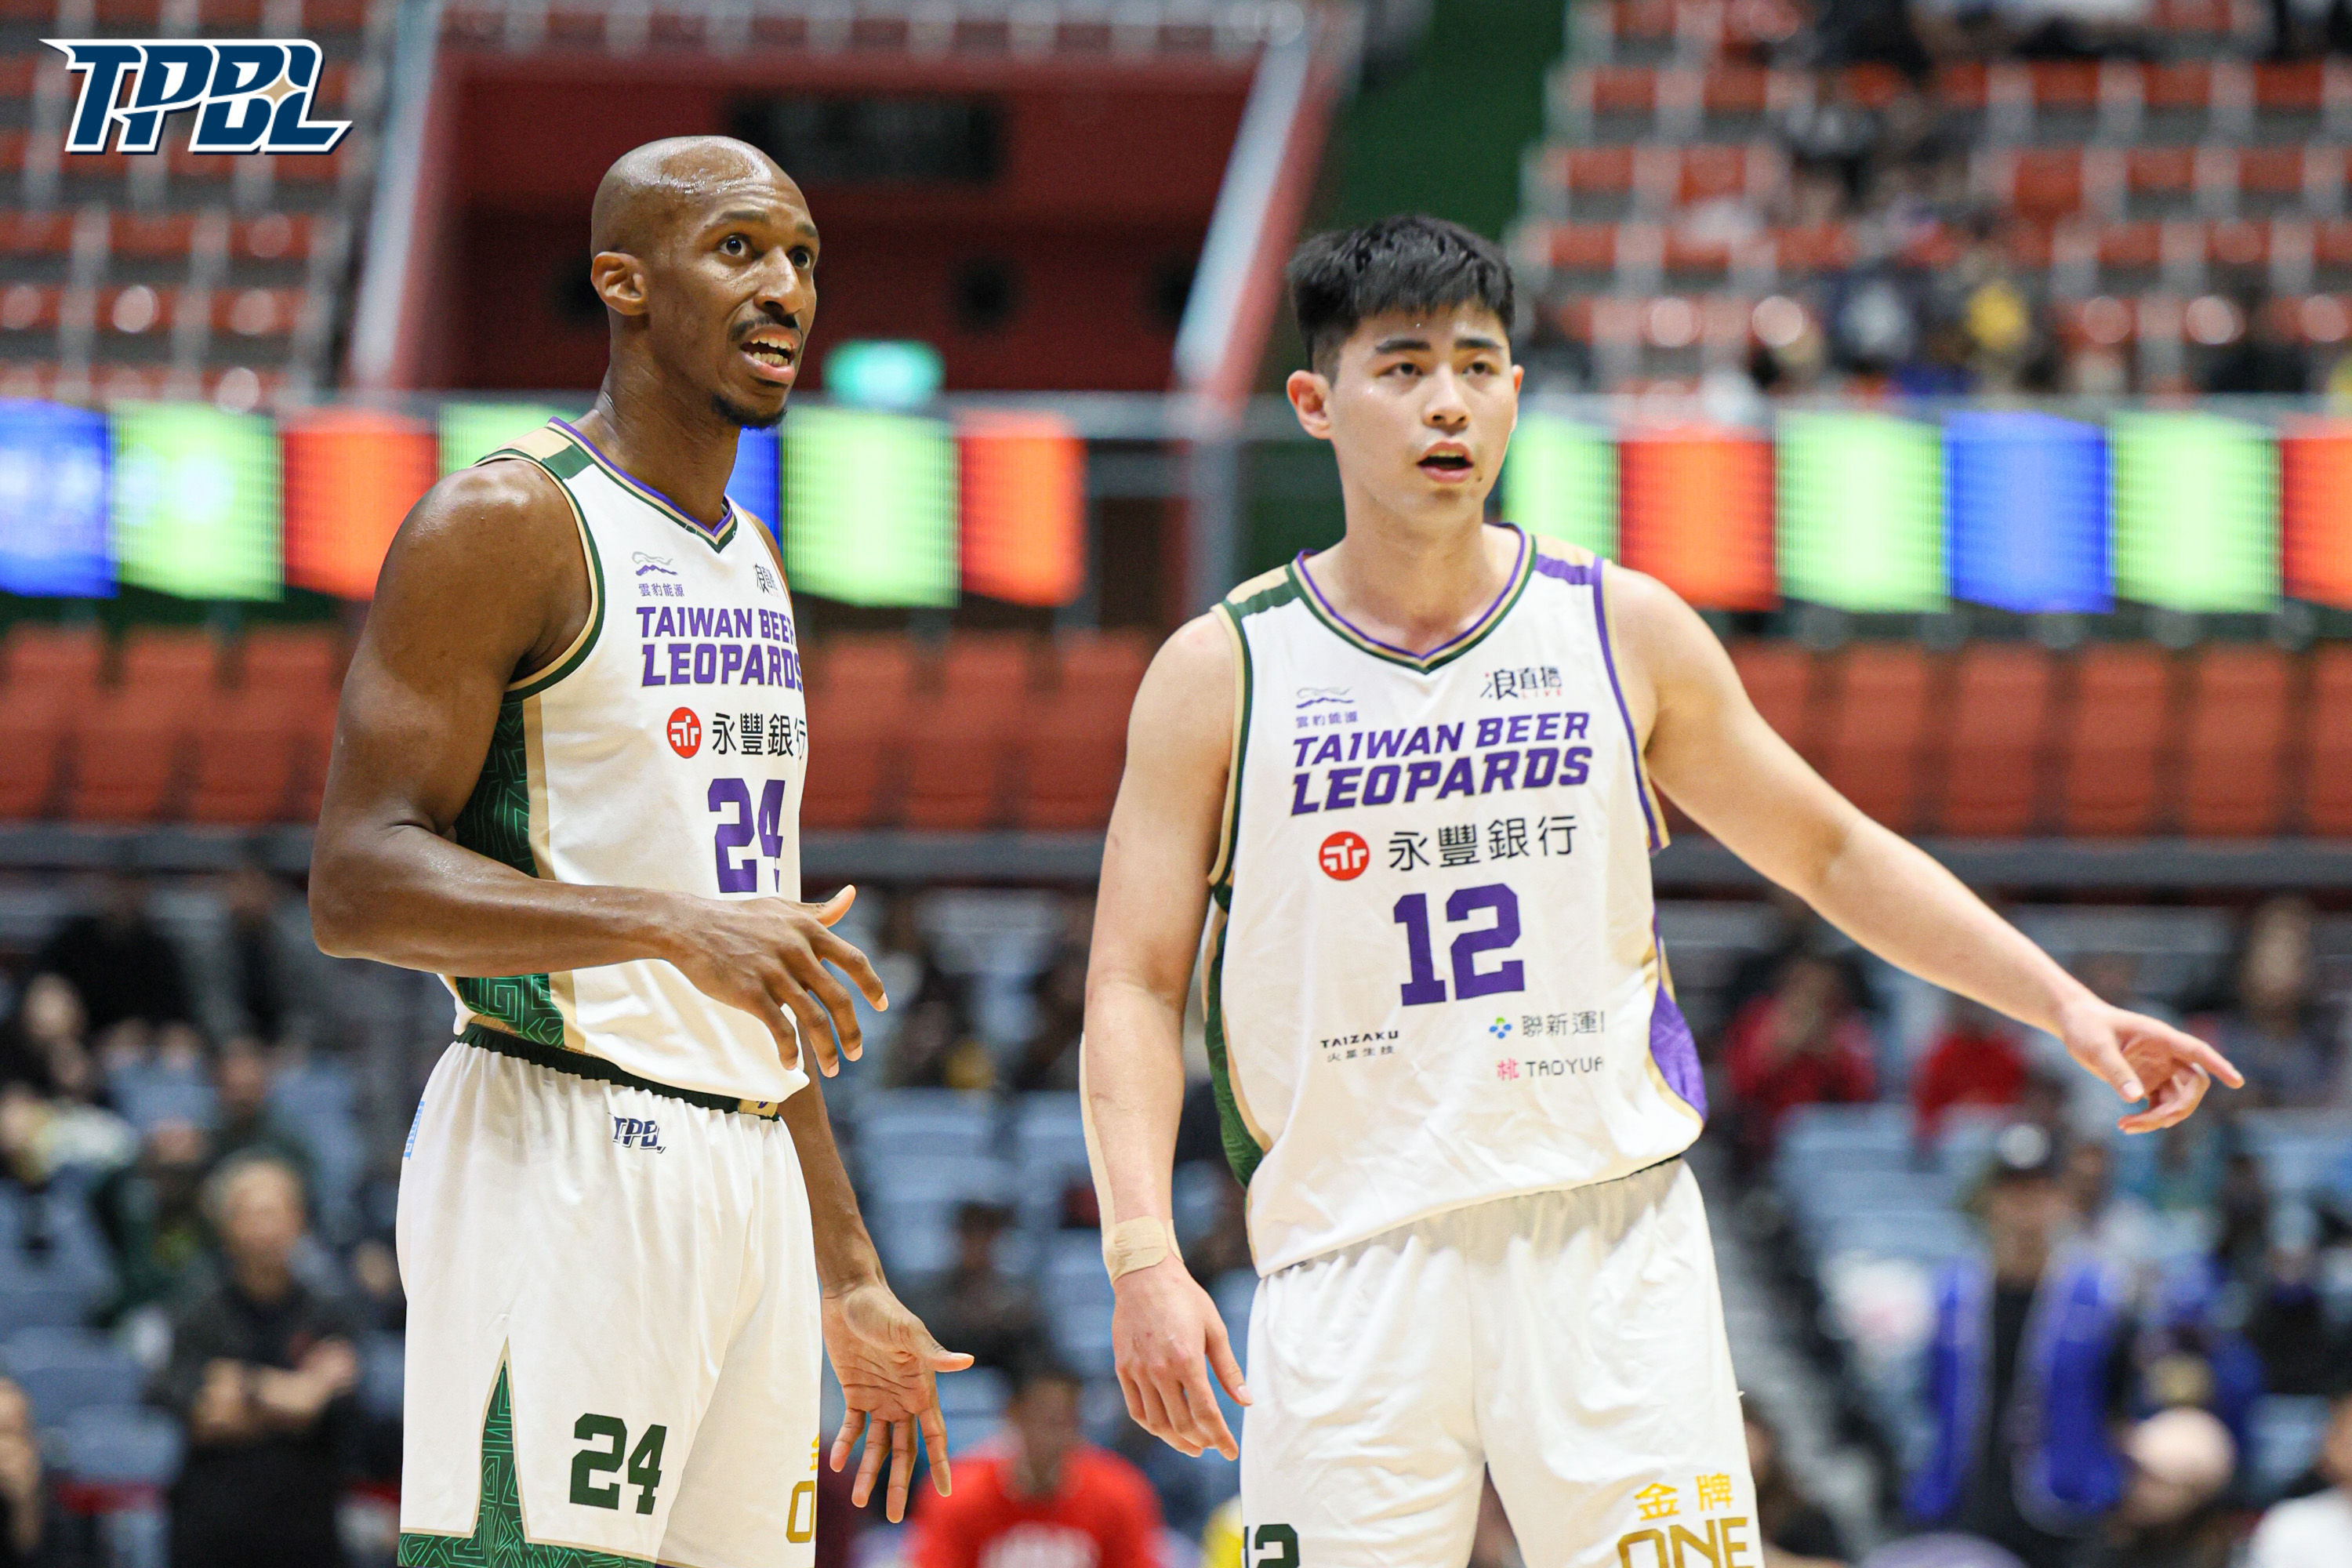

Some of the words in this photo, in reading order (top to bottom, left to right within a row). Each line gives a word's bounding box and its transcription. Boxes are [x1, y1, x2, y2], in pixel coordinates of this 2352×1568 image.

[639, 583, 684, 597] 雲豹能源
[636, 606, 753, 638] TAIWAN
[641, 643, 803, 693] LEOPARDS
[712, 712, 806, 760] 永豐銀行
[1294, 722, 1465, 768] TAIWAN
[1475, 712, 1590, 748] BEER
[1290, 746, 1592, 817] LEOPARDS
[707, 778, 786, 893] 24
[1388, 815, 1577, 871] 永豐銀行
[1393, 883, 1525, 1006] 12
[1320, 1030, 1399, 1049] TAIZAKU
[1522, 1011, 1605, 1037] 聯新運
[569, 1413, 667, 1515] 24
[1634, 1472, 1734, 1522] 金牌
[1617, 1517, 1755, 1568] ONE
